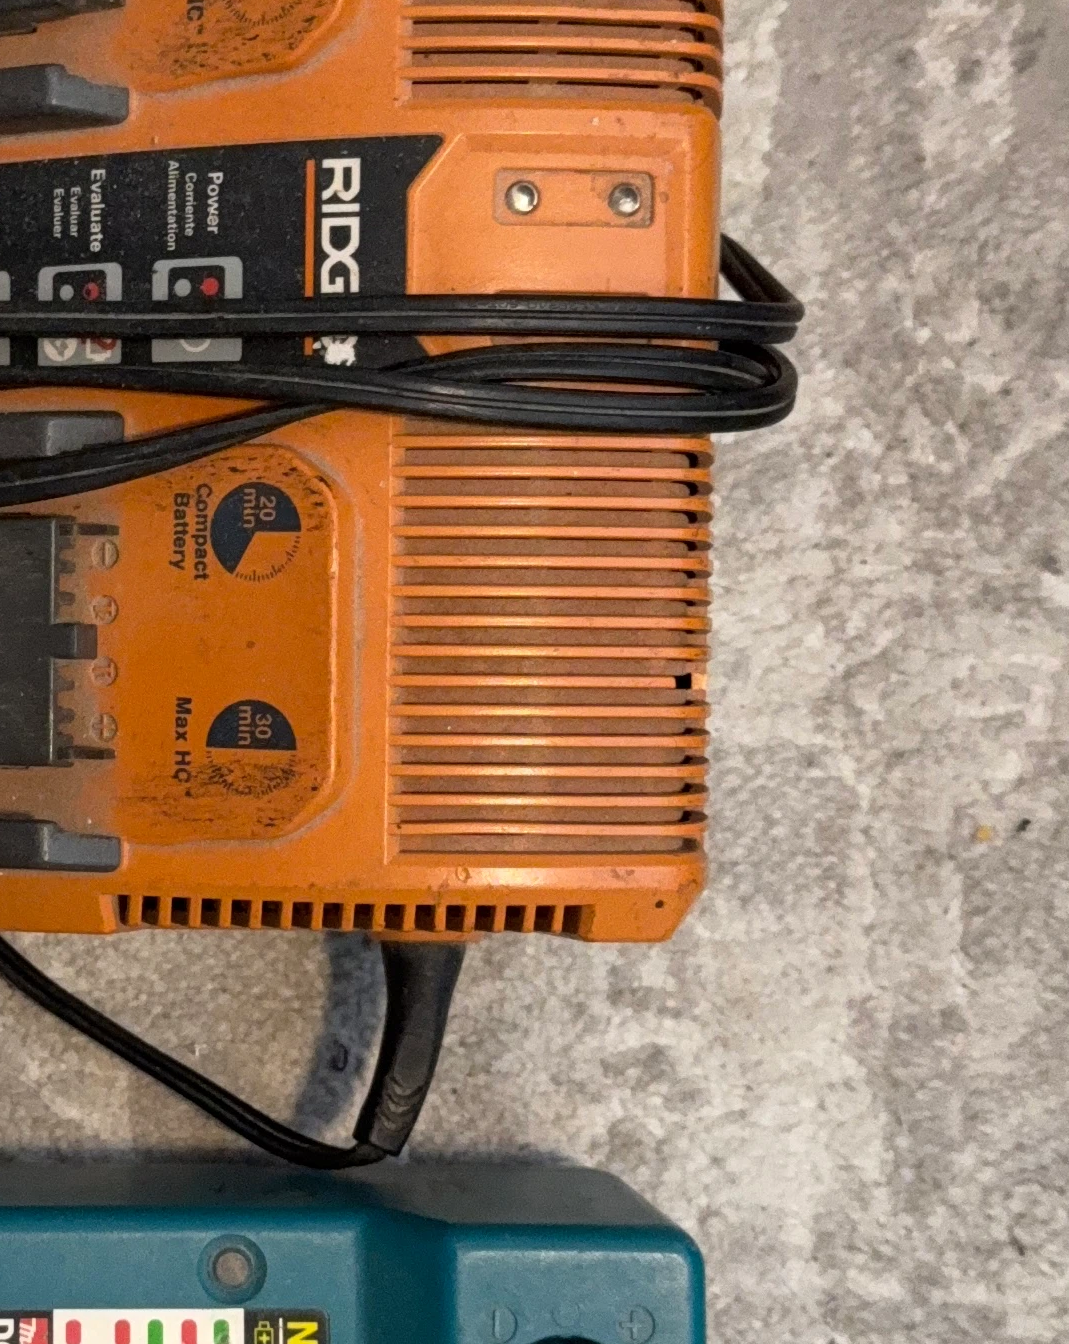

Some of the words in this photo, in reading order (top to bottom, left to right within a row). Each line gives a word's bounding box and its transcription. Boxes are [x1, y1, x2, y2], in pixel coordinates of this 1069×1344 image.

[53, 188, 64, 238] Evaluer
[70, 187, 81, 237] Evaluar
[90, 168, 106, 252] Evaluate
[167, 160, 179, 251] Alimentation
[185, 172, 197, 236] Corriente
[207, 172, 224, 234] Power
[169, 492, 189, 570] Battery
[191, 483, 212, 581] Compact
[243, 488, 258, 528] min
[259, 496, 276, 521] 20
[174, 697, 192, 741] Max
[238, 706, 253, 746] min
[255, 714, 272, 739] 30
